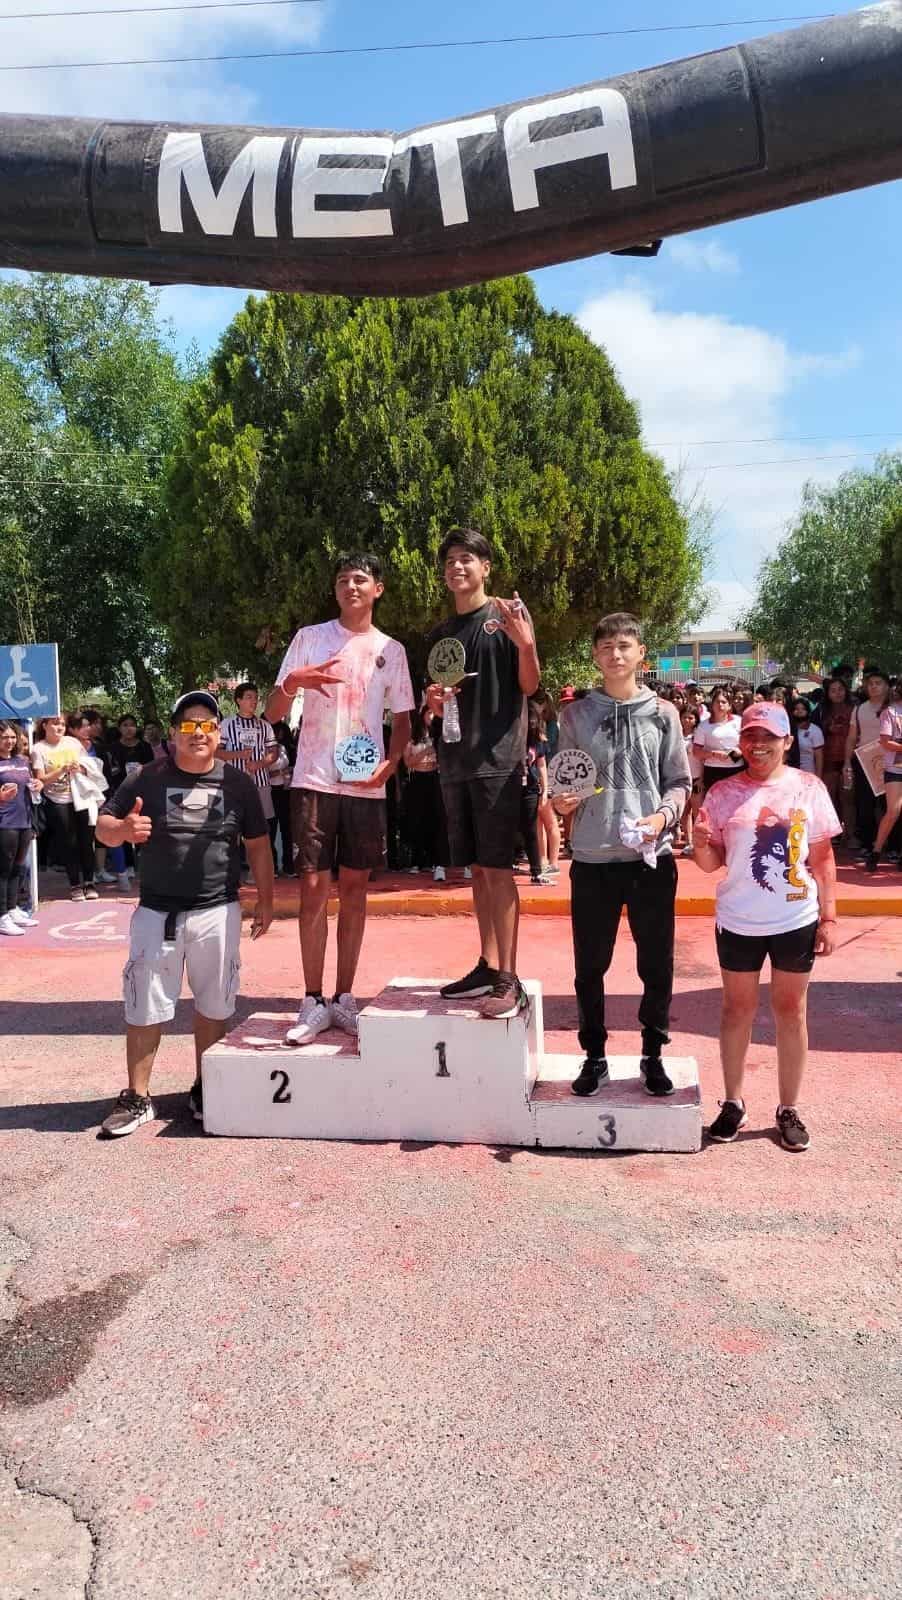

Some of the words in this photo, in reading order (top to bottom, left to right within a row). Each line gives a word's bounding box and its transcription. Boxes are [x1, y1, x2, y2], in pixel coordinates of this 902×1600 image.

[157, 87, 638, 240] META
[365, 748, 375, 763] 2
[576, 762, 588, 778] 3
[435, 1041, 451, 1077] 1
[270, 1070, 292, 1103] 2
[597, 1113, 617, 1146] 3
